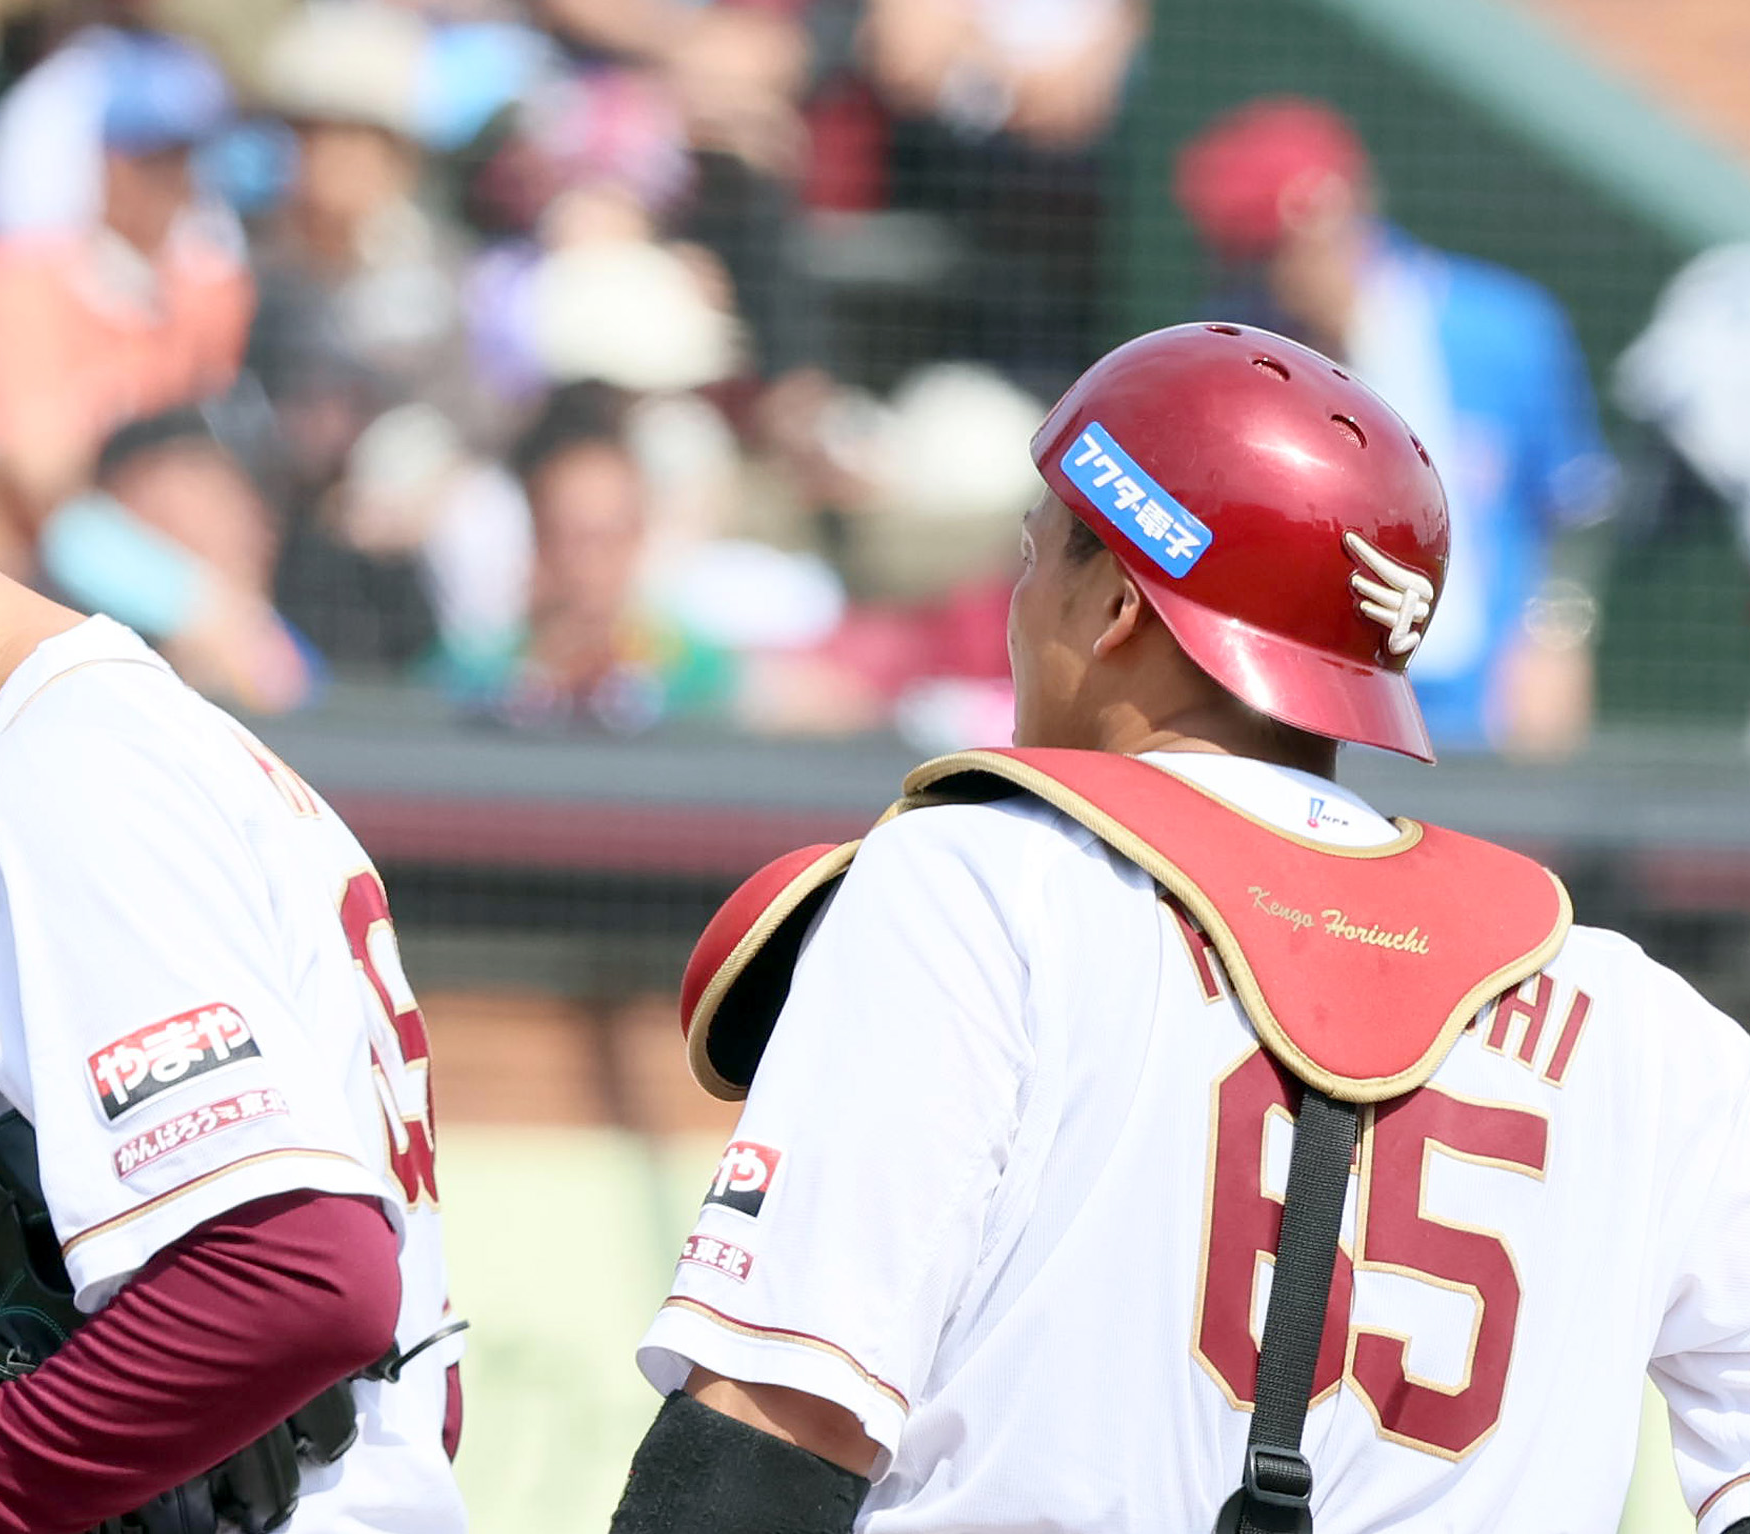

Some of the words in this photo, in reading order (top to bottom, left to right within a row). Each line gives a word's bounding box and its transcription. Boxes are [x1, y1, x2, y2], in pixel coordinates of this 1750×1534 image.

[1075, 432, 1202, 560] フクダ電子
[1247, 885, 1315, 933] Kengo
[1320, 908, 1430, 955] Horiuchi
[96, 1005, 252, 1106] やまや
